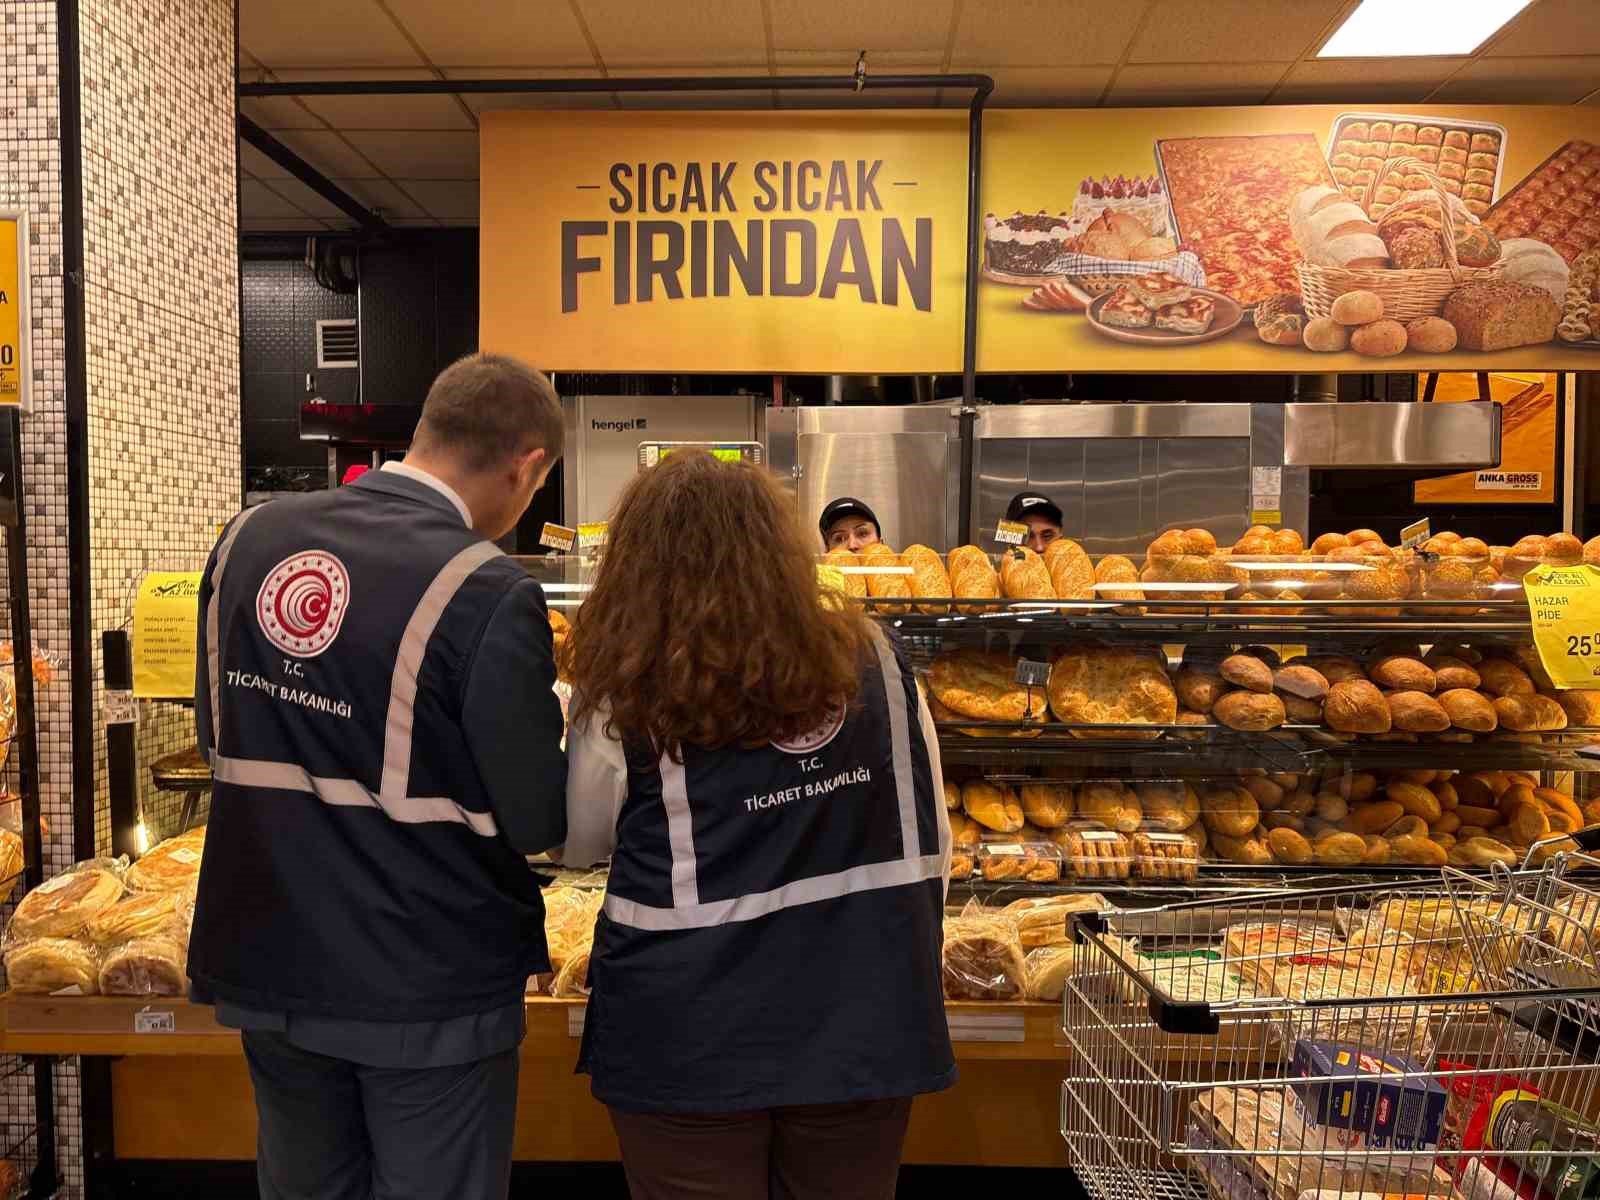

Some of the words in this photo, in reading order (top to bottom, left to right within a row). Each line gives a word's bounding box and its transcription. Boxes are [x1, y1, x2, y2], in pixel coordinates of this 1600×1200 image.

[608, 161, 738, 213] SICAK
[753, 159, 883, 212] SICAK
[561, 217, 932, 313] FIRINDAN
[592, 419, 634, 432] hengel
[1478, 474, 1505, 482] ANKA
[1506, 474, 1538, 483] GROSS
[1534, 596, 1568, 606] HAZAR
[1537, 610, 1561, 620] PİDE
[283, 659, 304, 678] T.C.
[280, 686, 352, 719] BAKANLIĞI
[798, 756, 824, 773] T.C.
[744, 786, 802, 812] TİCARET
